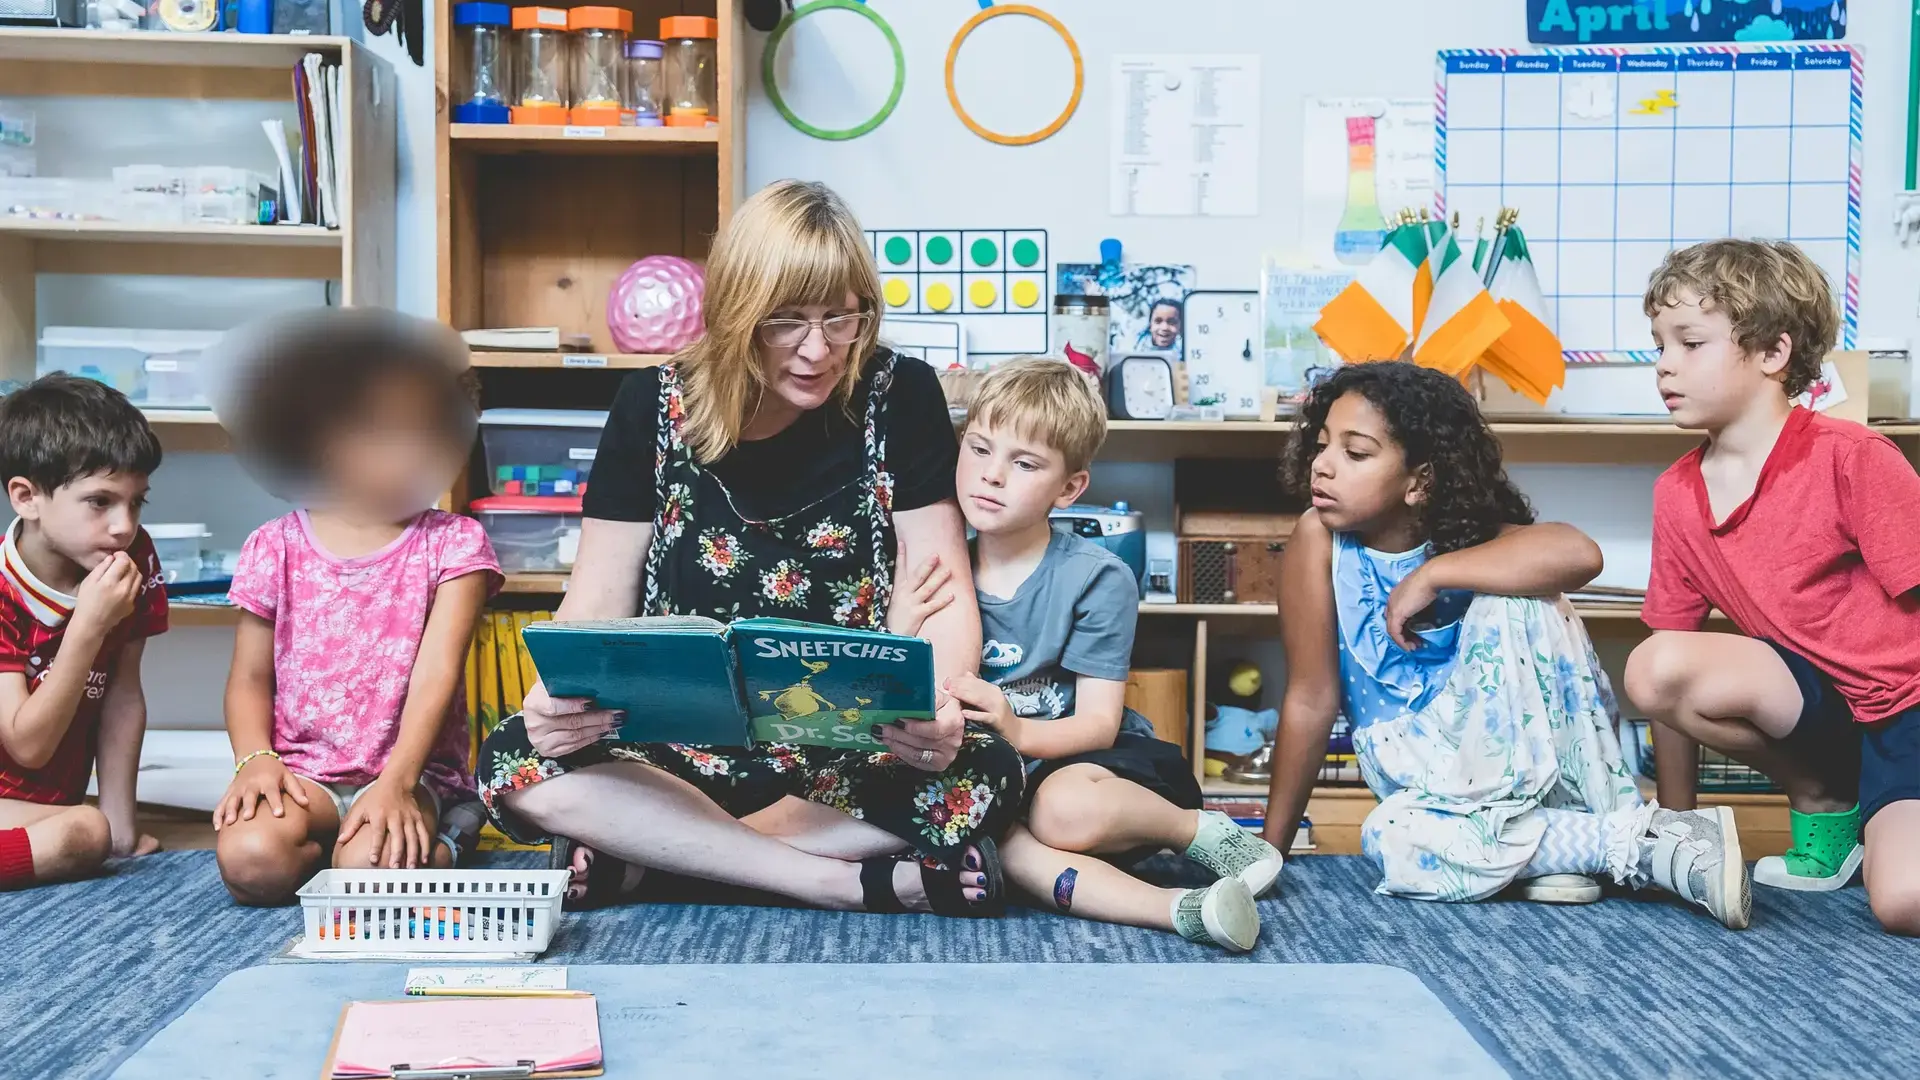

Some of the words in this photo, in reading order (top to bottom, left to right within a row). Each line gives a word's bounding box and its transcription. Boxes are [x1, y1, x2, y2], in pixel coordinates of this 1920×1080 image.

[1538, 0, 1670, 42] April
[1459, 60, 1490, 70] Sunday
[1515, 60, 1549, 70] Monday
[1572, 59, 1606, 70] Tuesday
[1627, 58, 1668, 69] Wednesday
[1687, 58, 1724, 69] Thursday
[1750, 57, 1779, 68] Friday
[1804, 56, 1842, 67] Saturday
[1217, 306, 1224, 318] 5
[1198, 323, 1210, 335] 10
[1191, 348, 1202, 360] 15
[1196, 374, 1210, 385] 20
[1240, 397, 1254, 408] 30
[753, 637, 909, 663] SNEETCHES
[770, 723, 826, 742] Dr.
